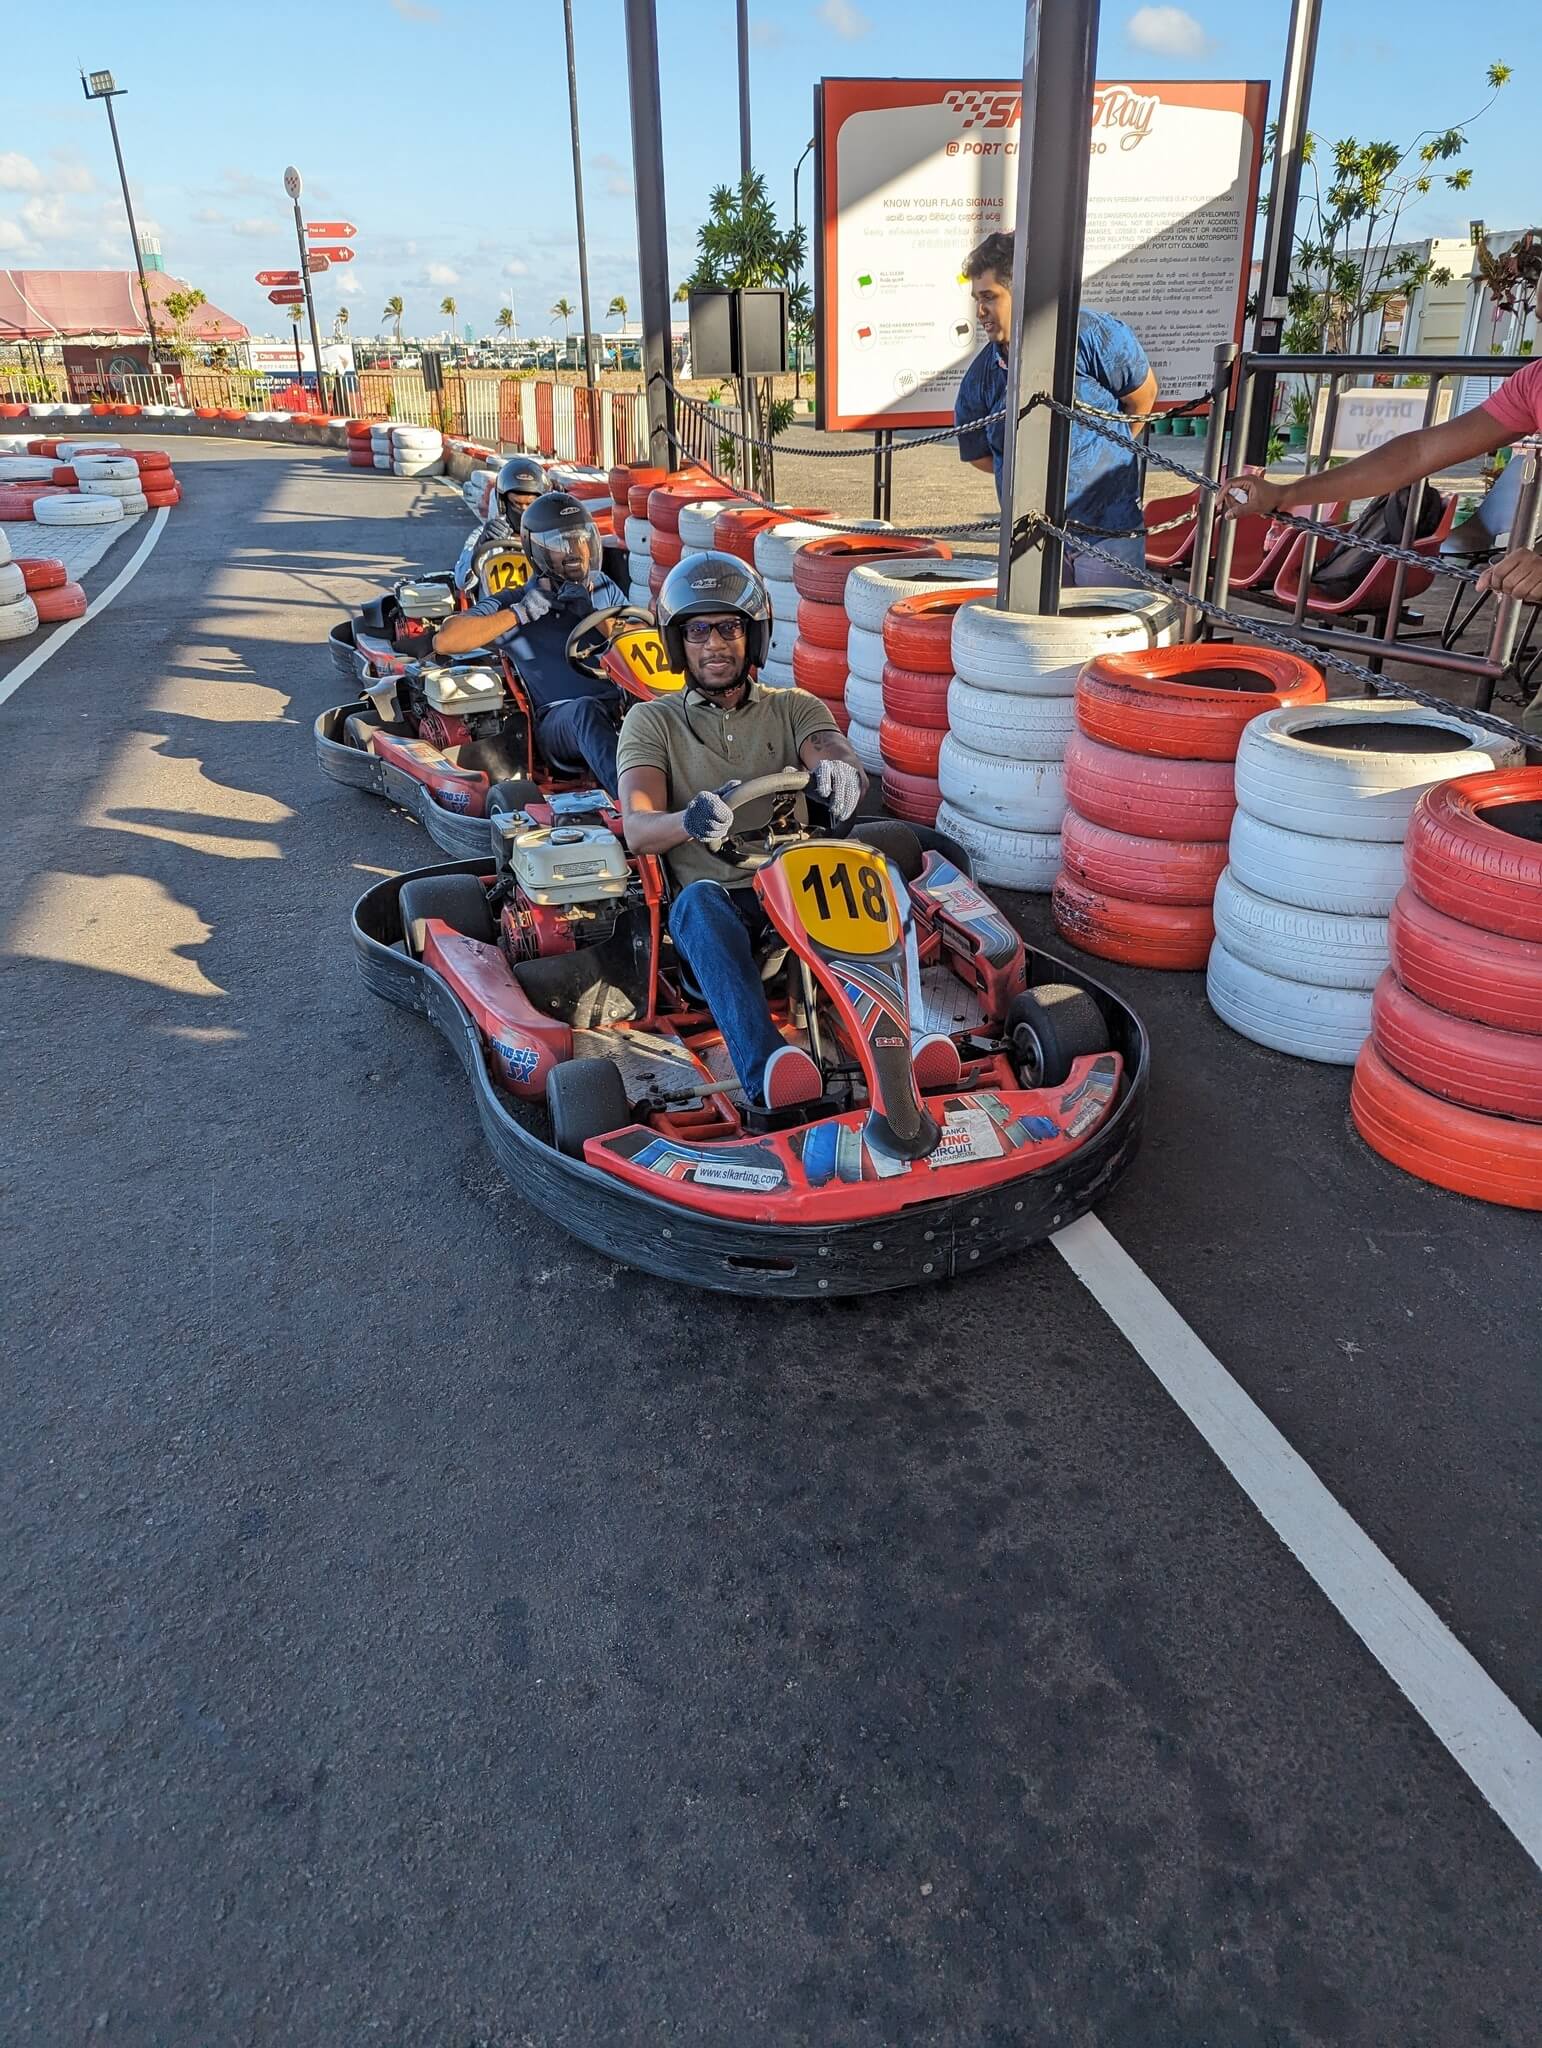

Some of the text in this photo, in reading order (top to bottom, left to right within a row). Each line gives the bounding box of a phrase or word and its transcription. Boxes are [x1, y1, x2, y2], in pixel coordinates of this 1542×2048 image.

[946, 143, 1018, 156] @ PORT CI
[884, 198, 1004, 208] KNOW YOUR FLAG SIGNALS
[490, 561, 529, 590] 121
[631, 641, 669, 675] 12
[802, 863, 888, 923] 118
[507, 1061, 536, 1084] SX
[941, 1135, 970, 1146] TING
[699, 1168, 780, 1185] www.slkarting.com
